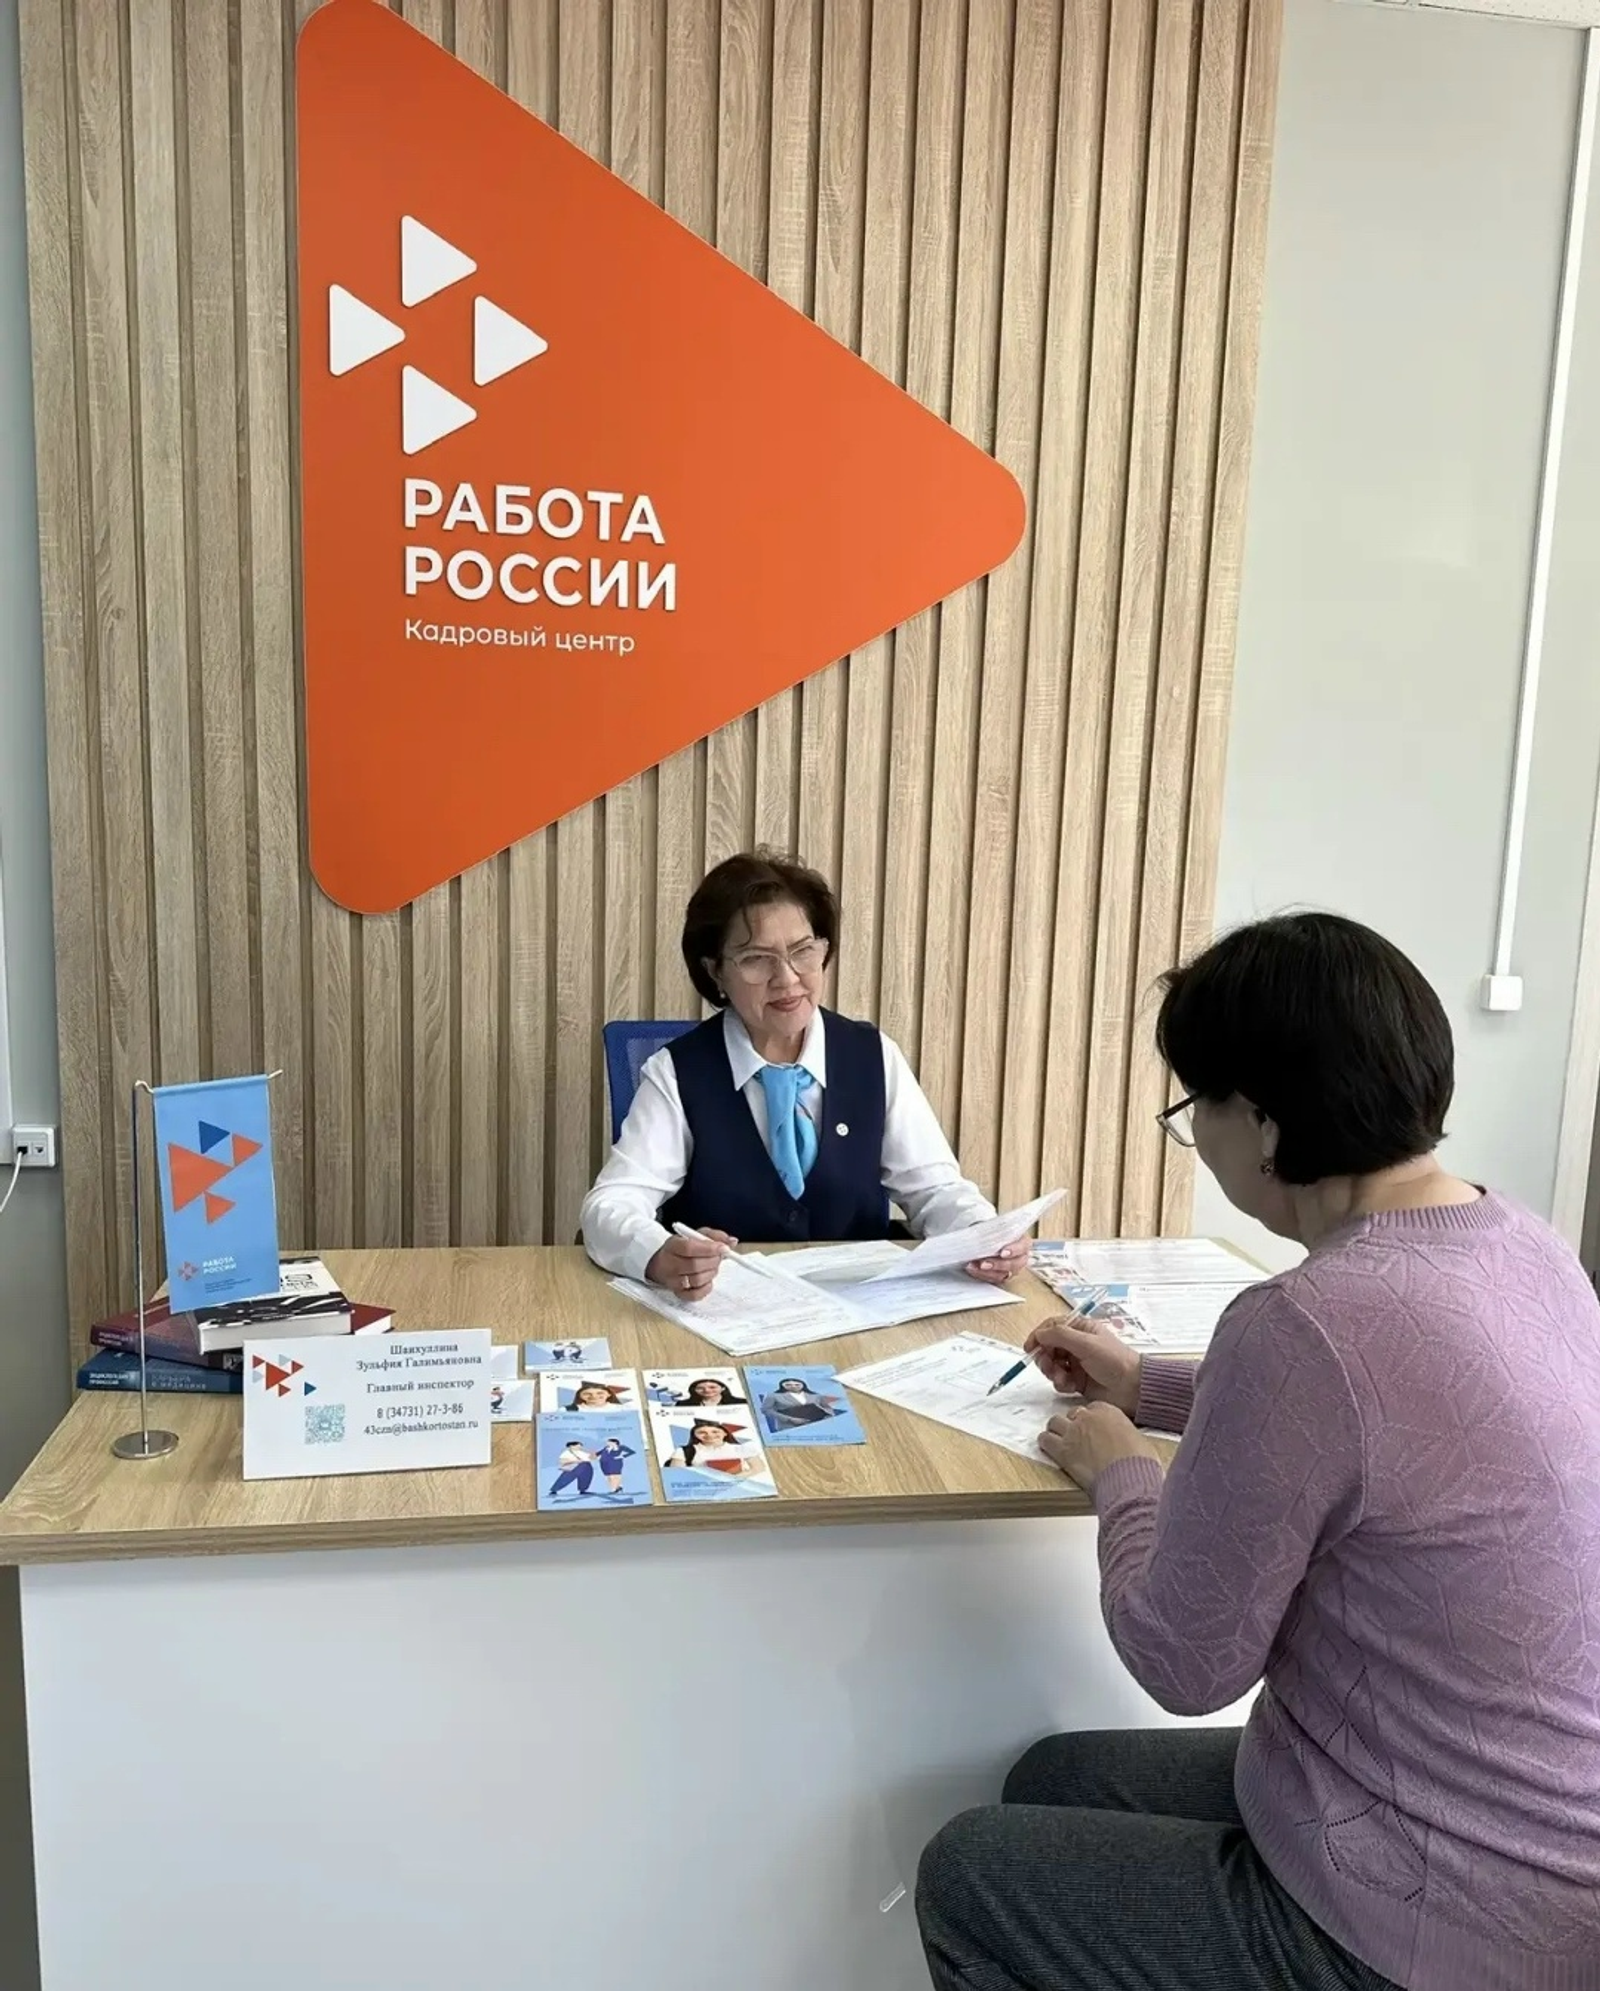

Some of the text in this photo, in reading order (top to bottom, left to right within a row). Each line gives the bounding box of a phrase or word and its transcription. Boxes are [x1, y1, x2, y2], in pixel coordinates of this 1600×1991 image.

[403, 477, 666, 545] РАБОТА
[404, 545, 677, 612] РОССИИ
[405, 618, 635, 657] Кадровый центр
[202, 1256, 234, 1268] РАБОТА
[203, 1263, 237, 1275] РОССИИ
[356, 1355, 482, 1372] Зульфия Галимьяновна
[367, 1379, 475, 1393] Главный инспектор
[376, 1407, 384, 1418] 8
[386, 1404, 424, 1419] (34731)
